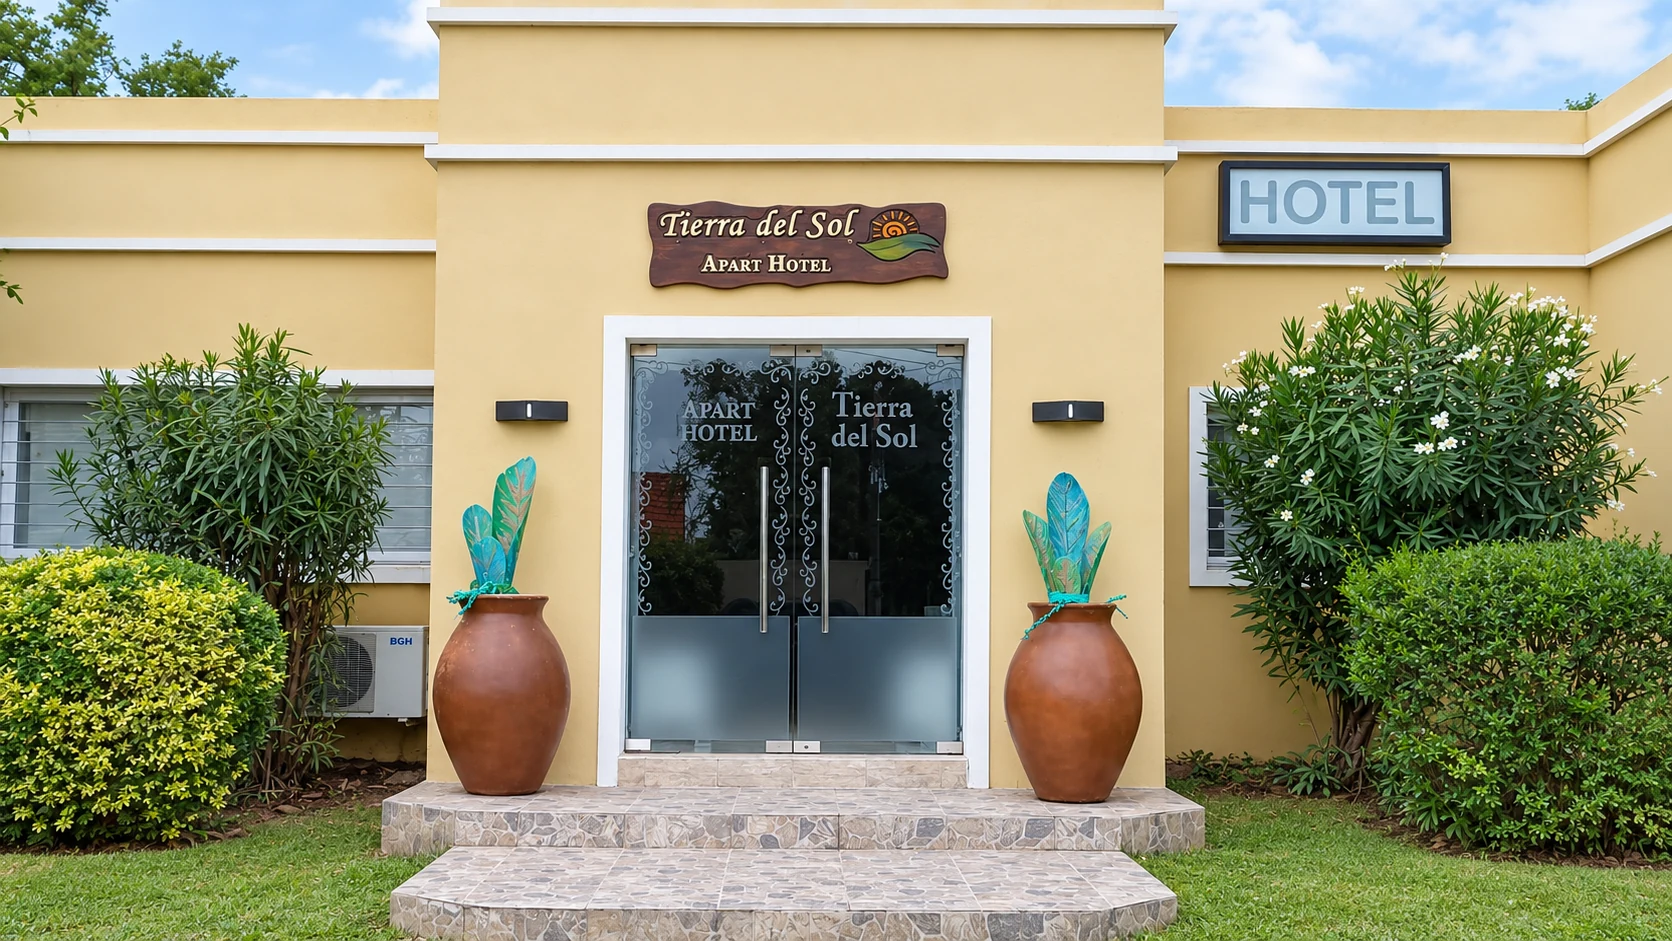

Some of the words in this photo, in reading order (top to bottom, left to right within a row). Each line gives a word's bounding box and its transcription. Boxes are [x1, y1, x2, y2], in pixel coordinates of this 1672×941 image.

[1240, 180, 1435, 224] HOTEL
[659, 210, 745, 238] Tierra
[756, 209, 803, 238] del
[805, 208, 860, 239] Sol
[700, 254, 763, 273] APART
[768, 253, 832, 273] HOTEL
[681, 399, 756, 420] APART
[831, 391, 914, 419] Tierra
[681, 424, 758, 443] HOTEL
[831, 423, 869, 448] del
[875, 423, 918, 448] Sol
[390, 637, 413, 645] BGH
